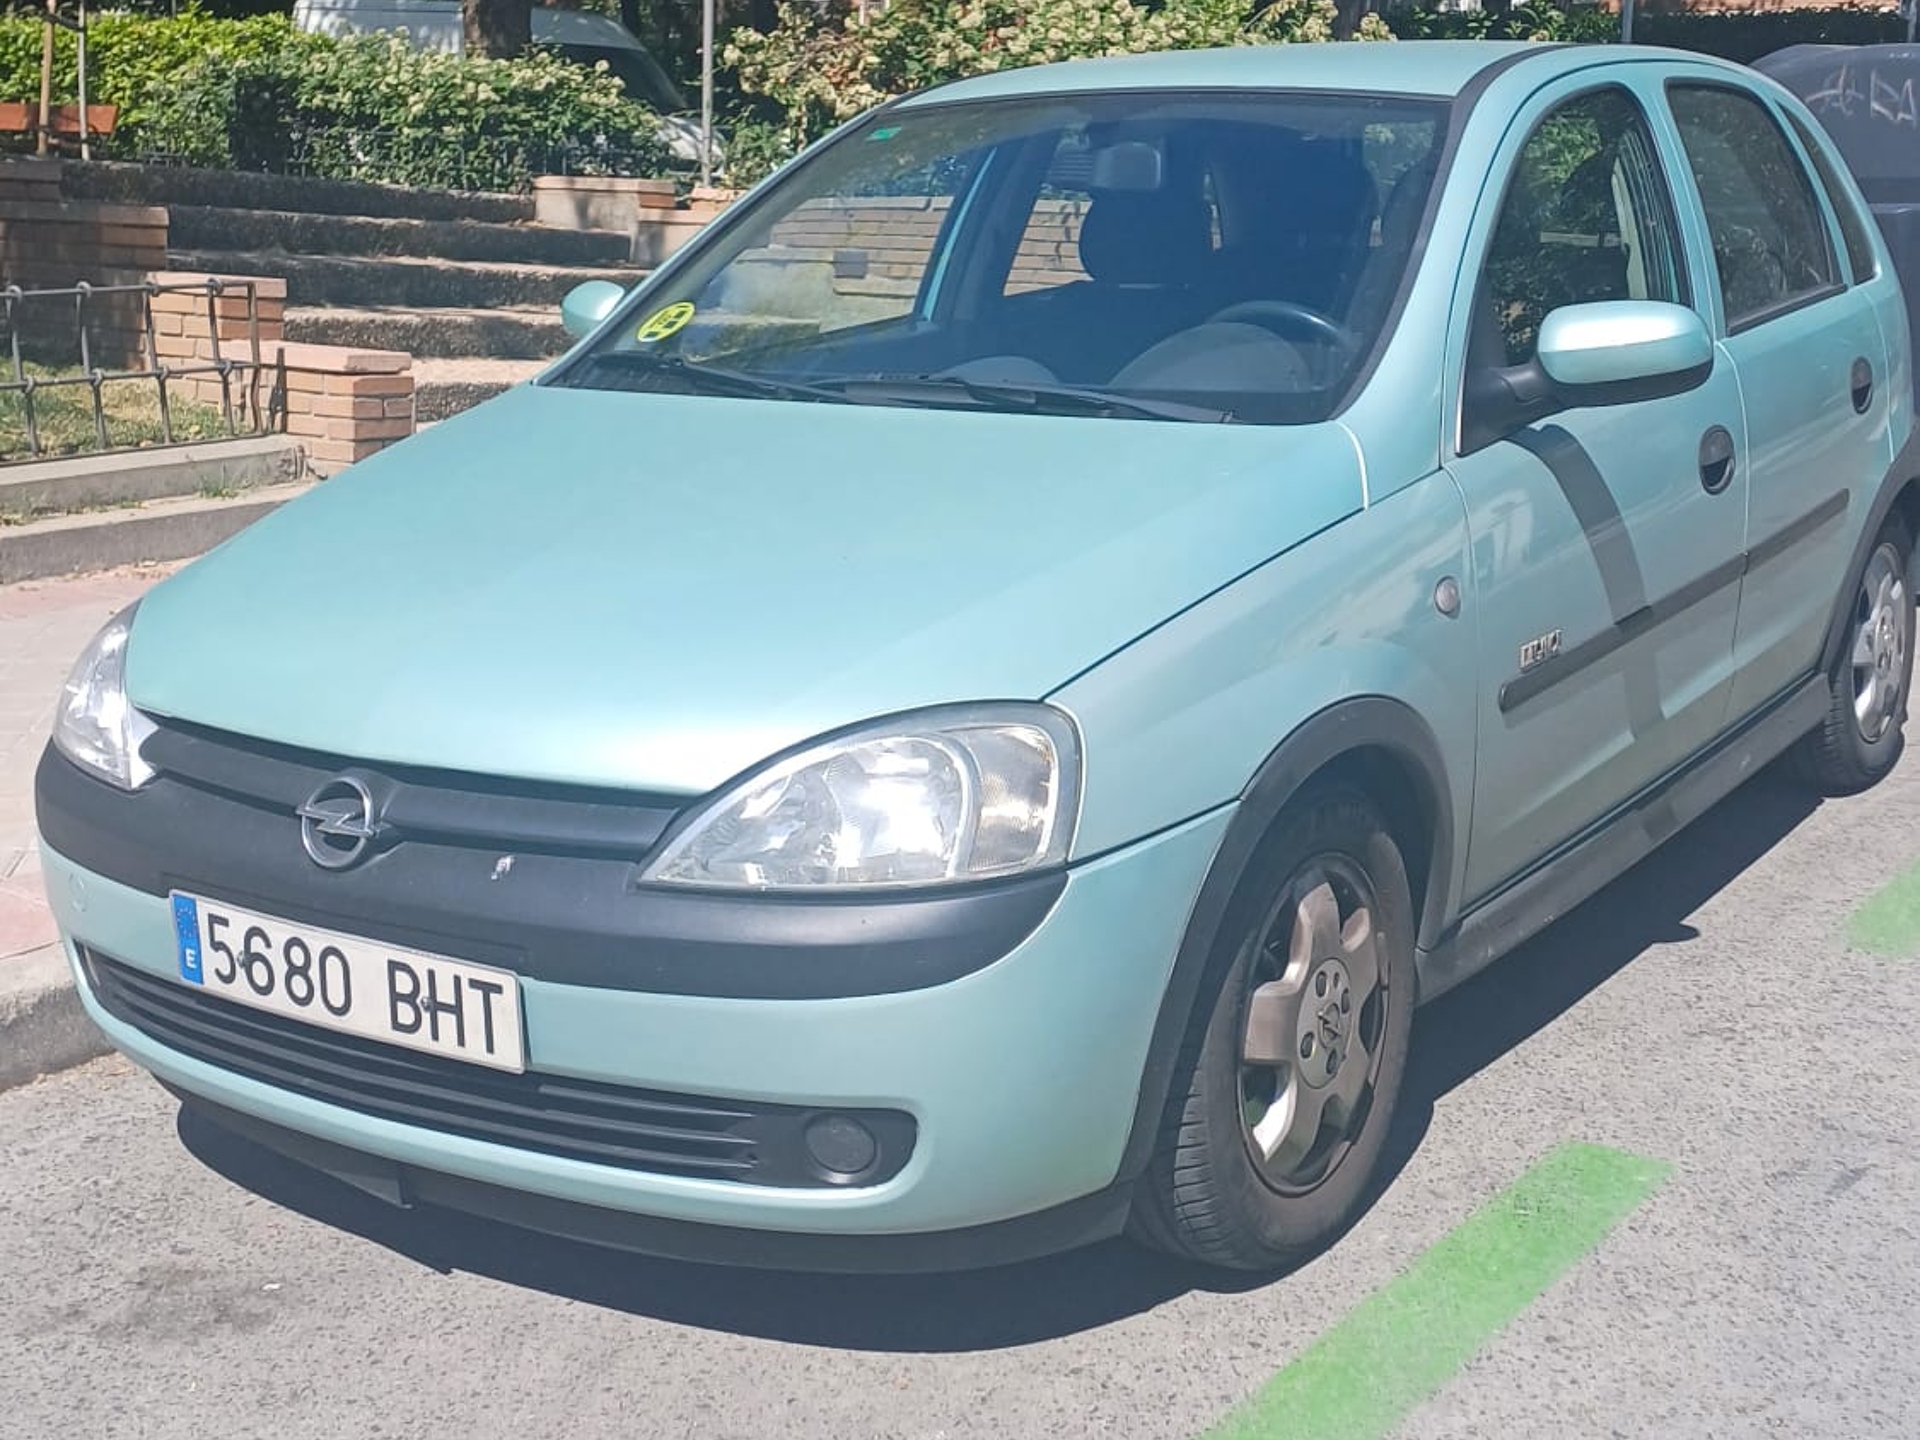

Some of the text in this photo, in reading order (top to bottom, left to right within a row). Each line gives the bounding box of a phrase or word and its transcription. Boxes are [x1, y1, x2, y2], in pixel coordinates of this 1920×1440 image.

[185, 948, 197, 969] E
[207, 913, 503, 1054] 5680 BHT
